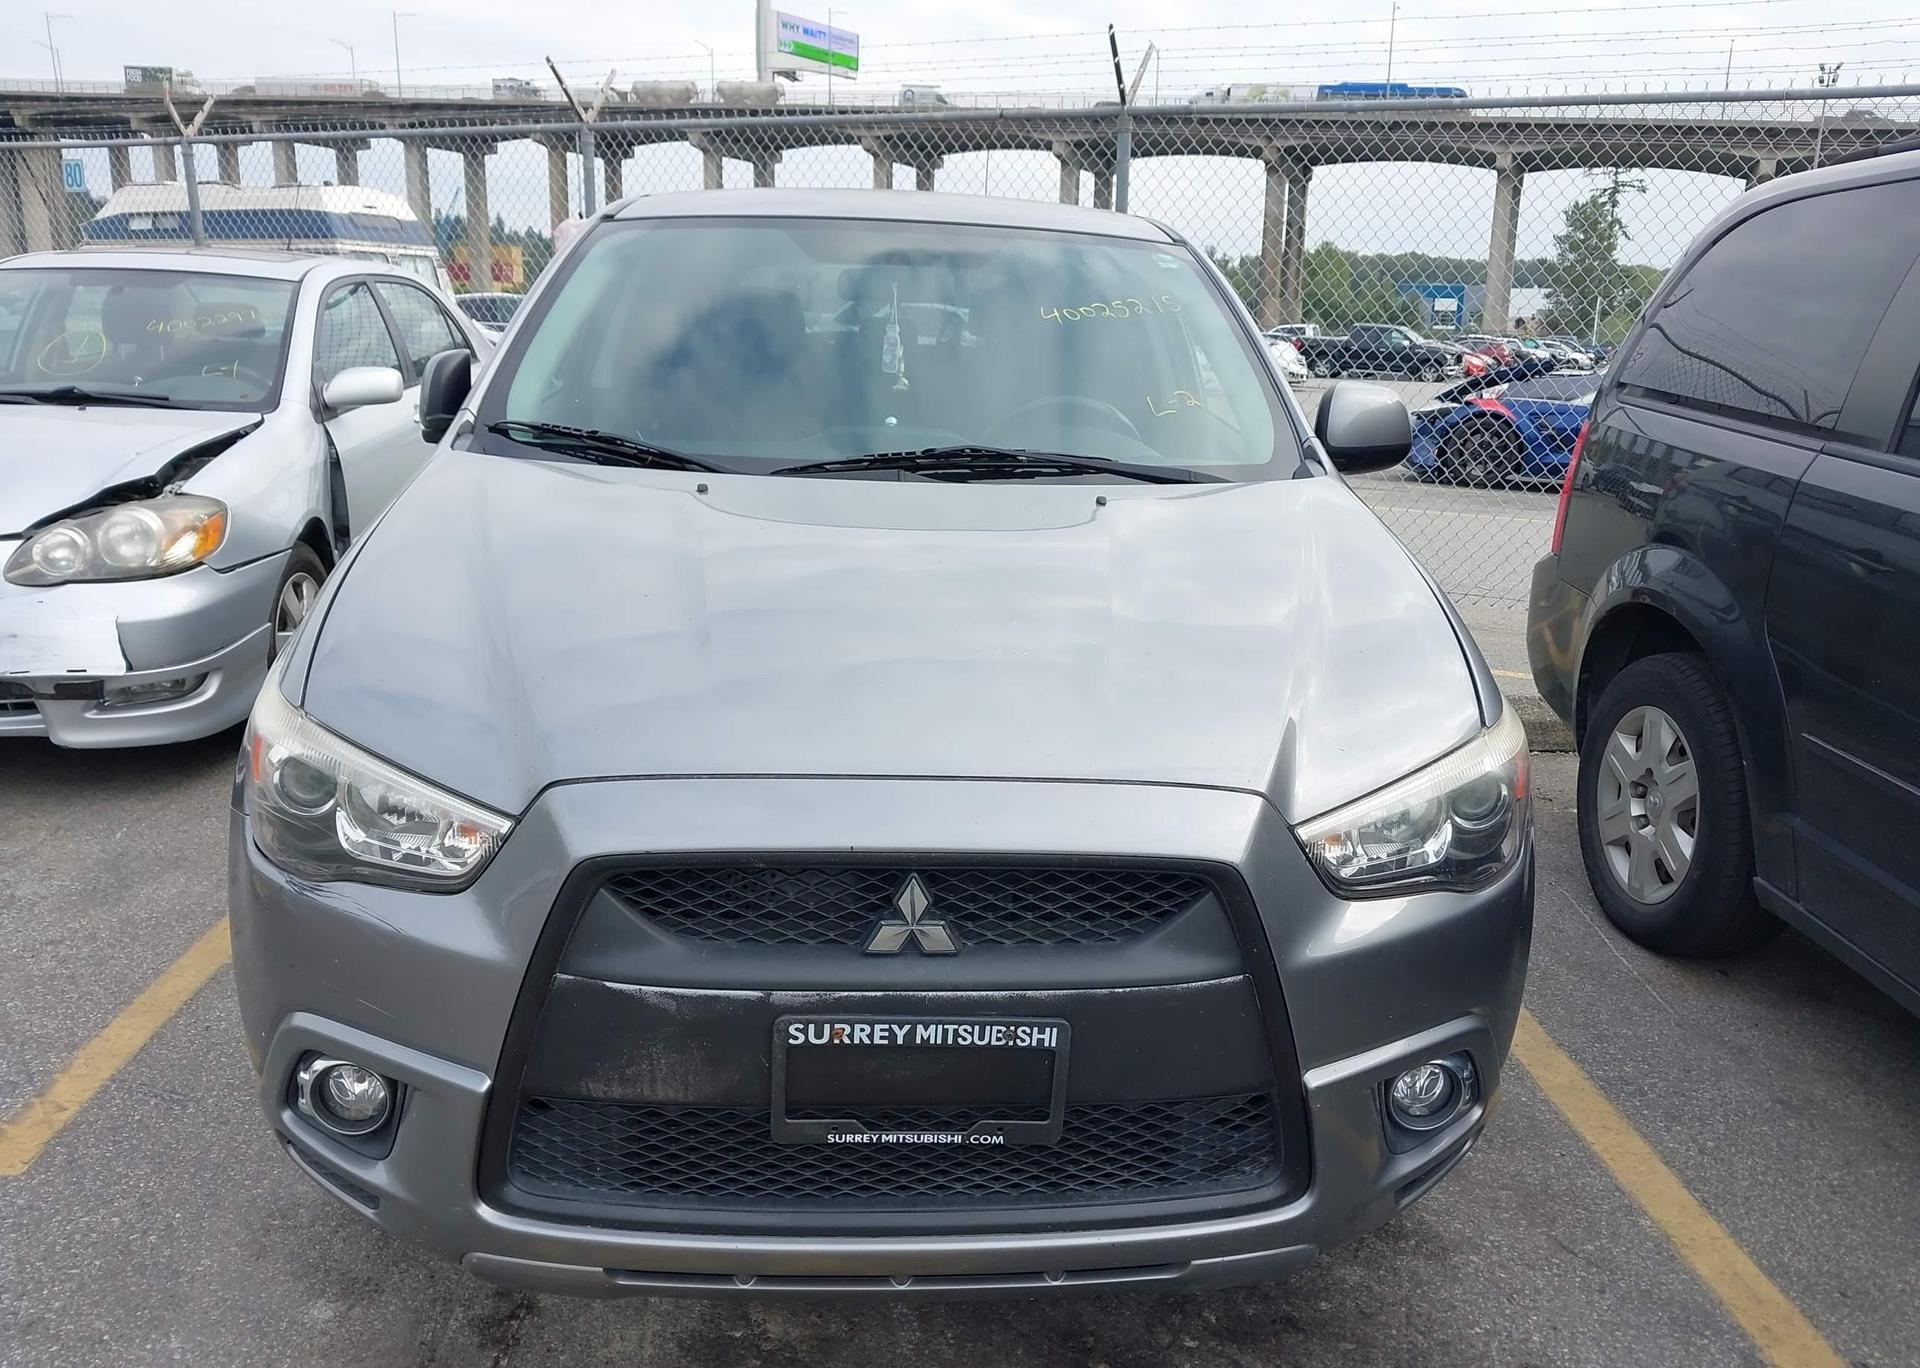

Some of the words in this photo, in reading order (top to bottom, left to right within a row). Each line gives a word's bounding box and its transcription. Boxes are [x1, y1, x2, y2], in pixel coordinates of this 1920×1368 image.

[780, 20, 801, 34] WHY
[802, 27, 827, 40] WAIT?
[64, 162, 83, 188] 80
[1040, 295, 1181, 325] 40025215
[1147, 390, 1201, 417] L-2
[787, 1023, 912, 1045] SURREY
[915, 1024, 1058, 1047] MITSUBISHI
